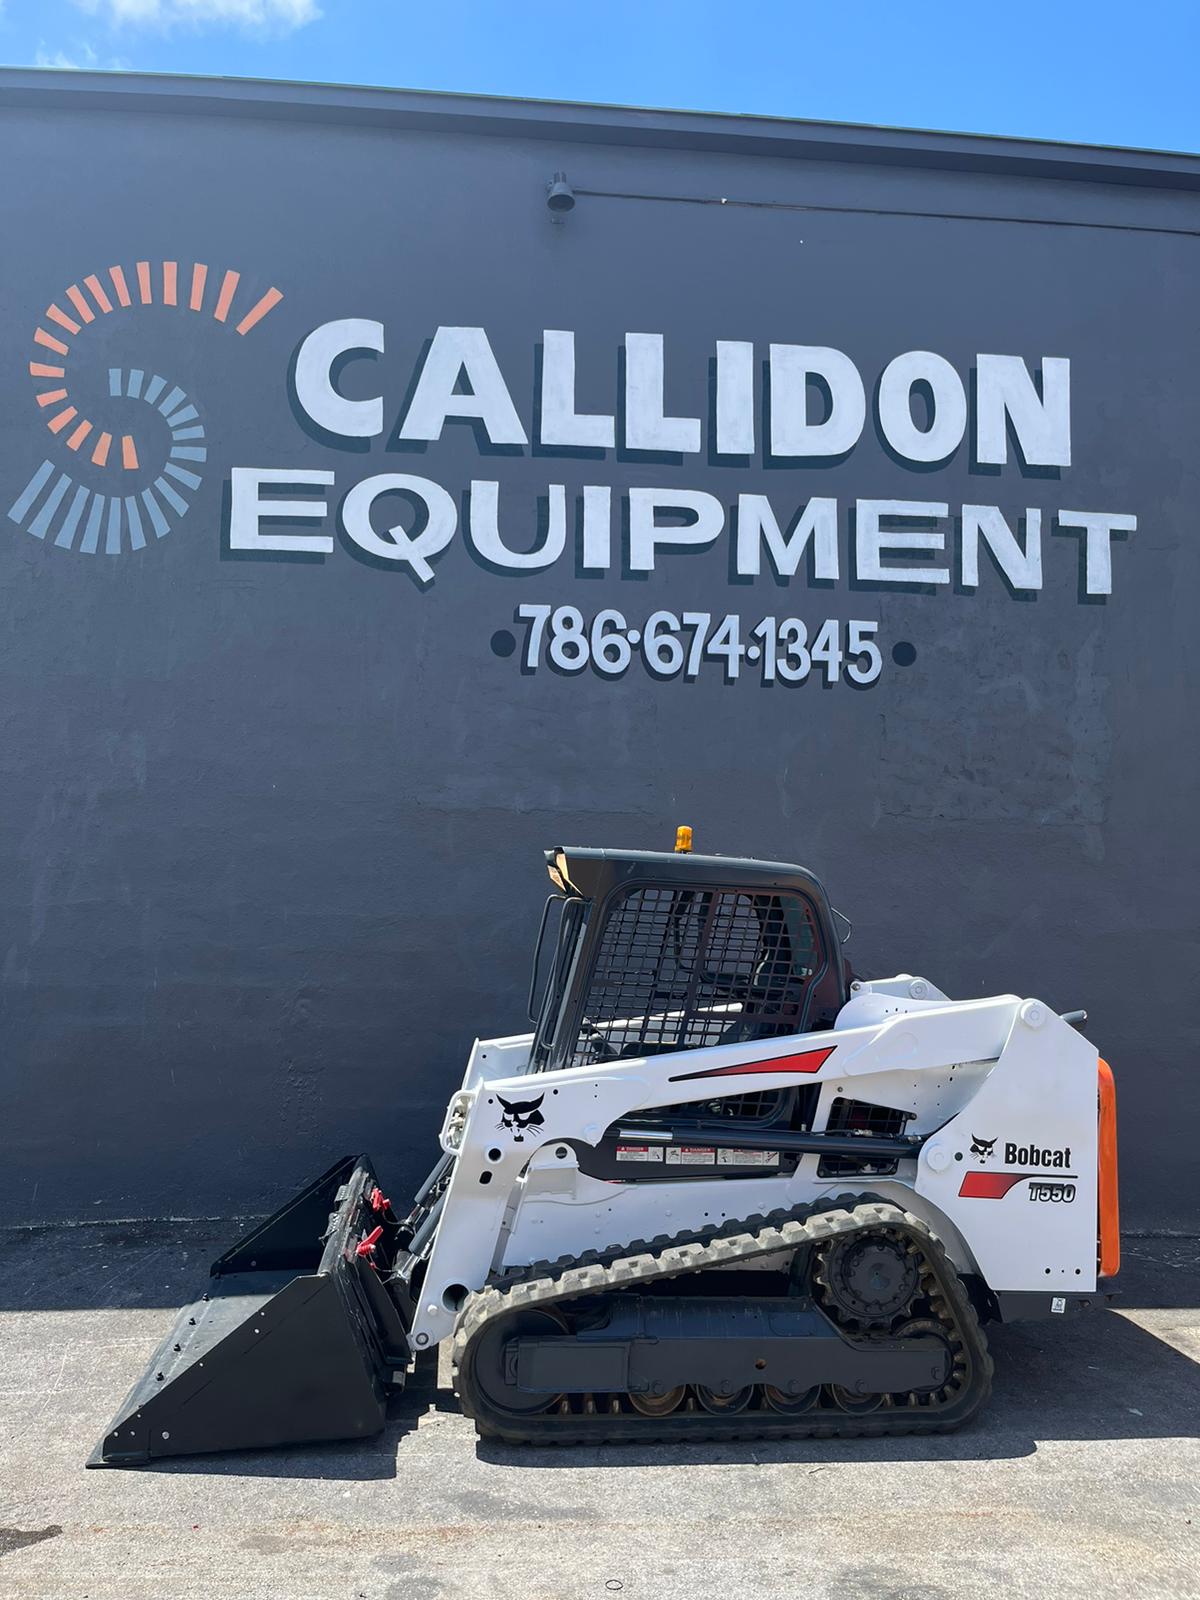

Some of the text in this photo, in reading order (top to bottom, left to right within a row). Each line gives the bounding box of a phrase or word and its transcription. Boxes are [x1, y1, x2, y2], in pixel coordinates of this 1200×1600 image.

[294, 318, 1072, 467] CALLIDON
[229, 467, 1137, 595] EQUIPMENT
[1005, 1142, 1071, 1168] Bobcat
[1028, 1182, 1076, 1203] T550
